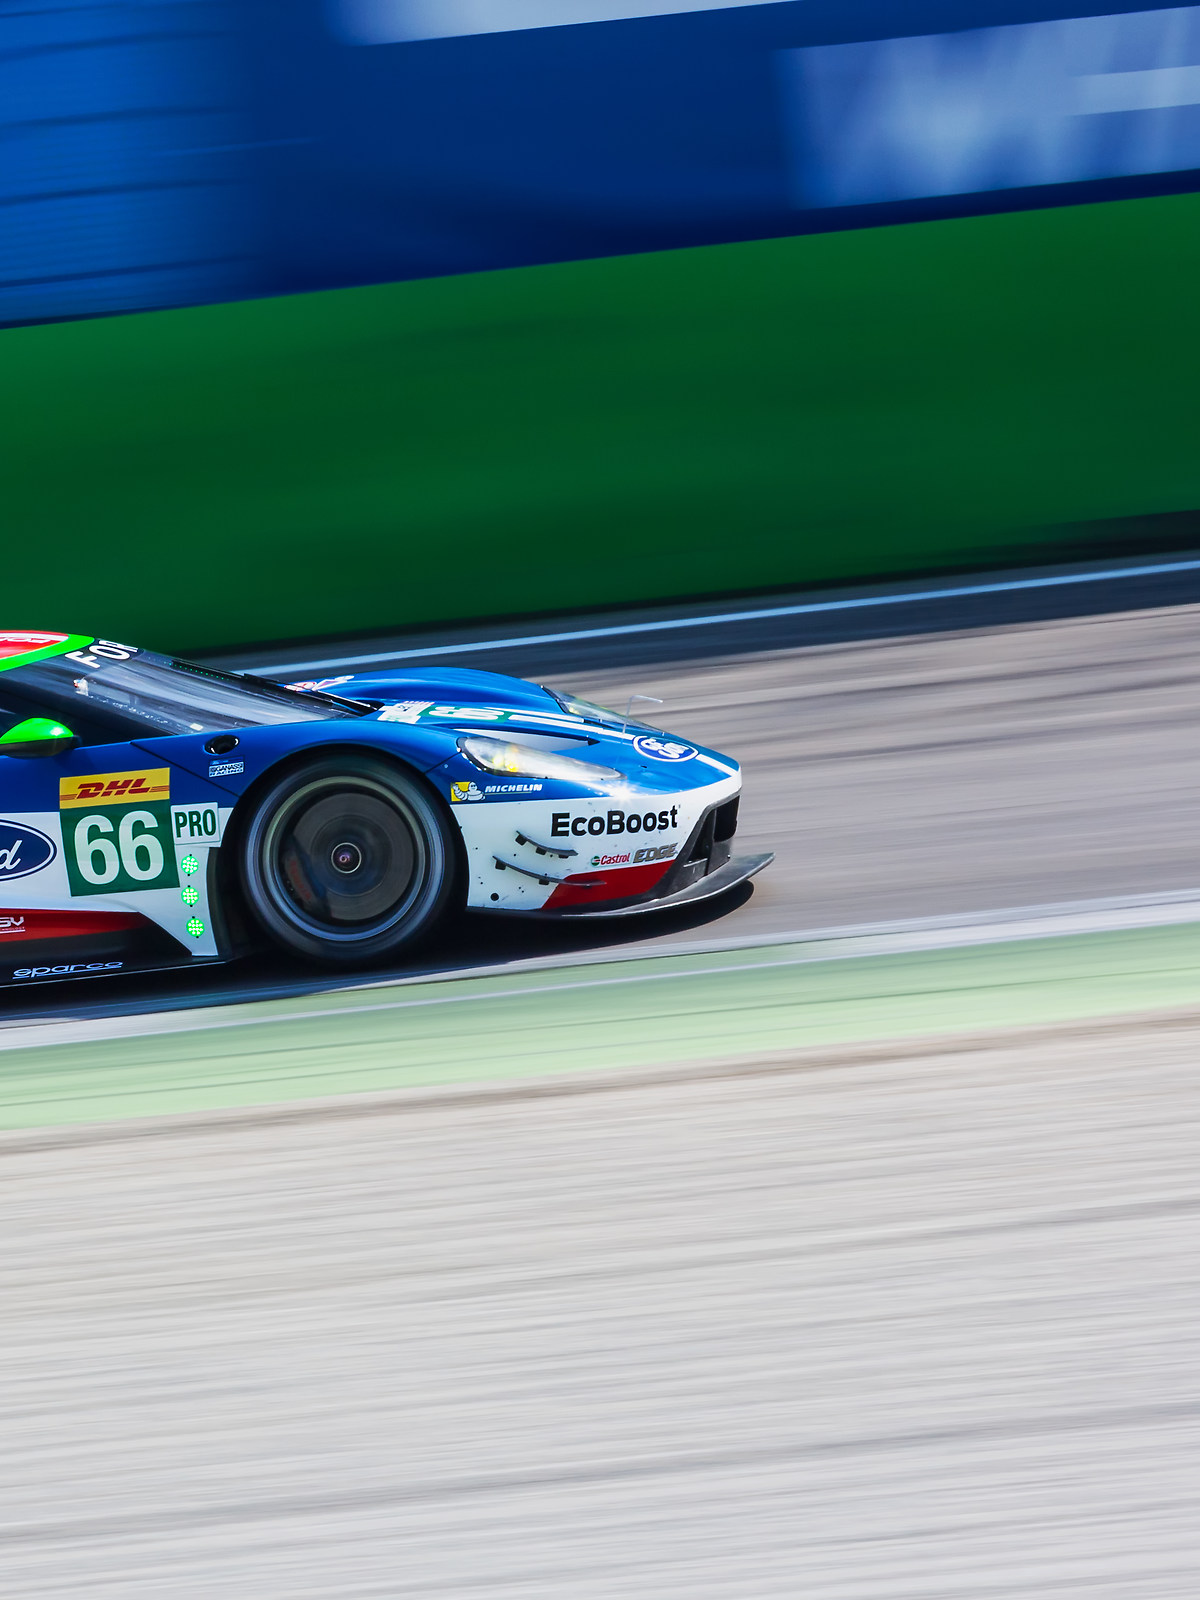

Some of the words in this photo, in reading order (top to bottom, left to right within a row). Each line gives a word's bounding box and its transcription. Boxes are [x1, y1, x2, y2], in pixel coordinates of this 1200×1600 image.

[76, 777, 151, 800] DHL
[484, 783, 543, 793] MICHELIN
[174, 808, 217, 838] PRO
[550, 805, 678, 837] EcoBoost
[74, 810, 165, 885] 66
[600, 852, 631, 866] Castrol
[632, 842, 679, 864] EDGE
[12, 961, 124, 979] sparco
